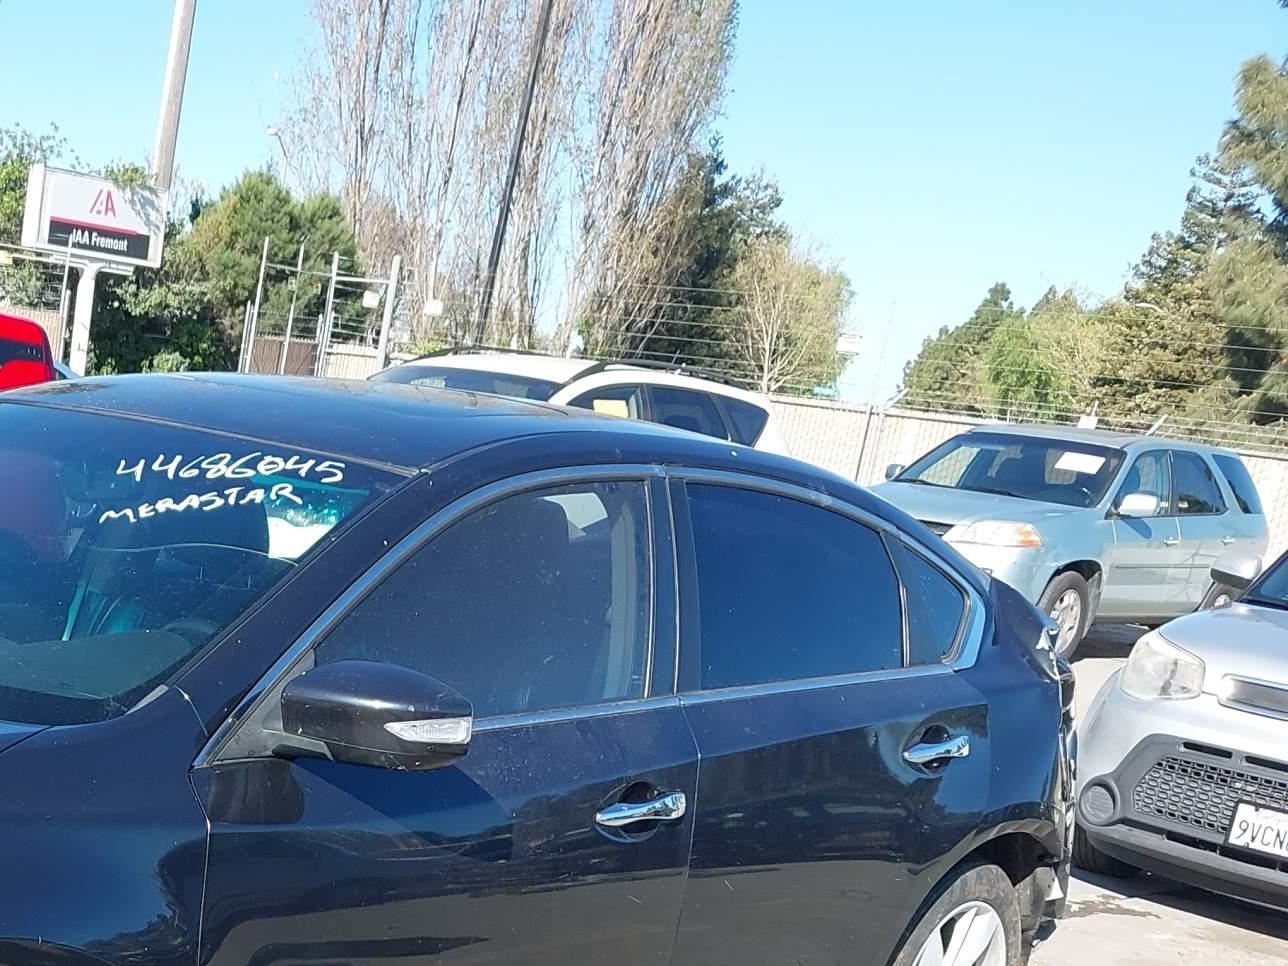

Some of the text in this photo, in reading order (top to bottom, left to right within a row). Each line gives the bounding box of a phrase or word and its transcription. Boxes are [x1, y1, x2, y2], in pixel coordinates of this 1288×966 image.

[72, 228, 128, 252] IAA Fremont
[116, 452, 346, 483] 44686045
[99, 483, 304, 524] MERASTAR
